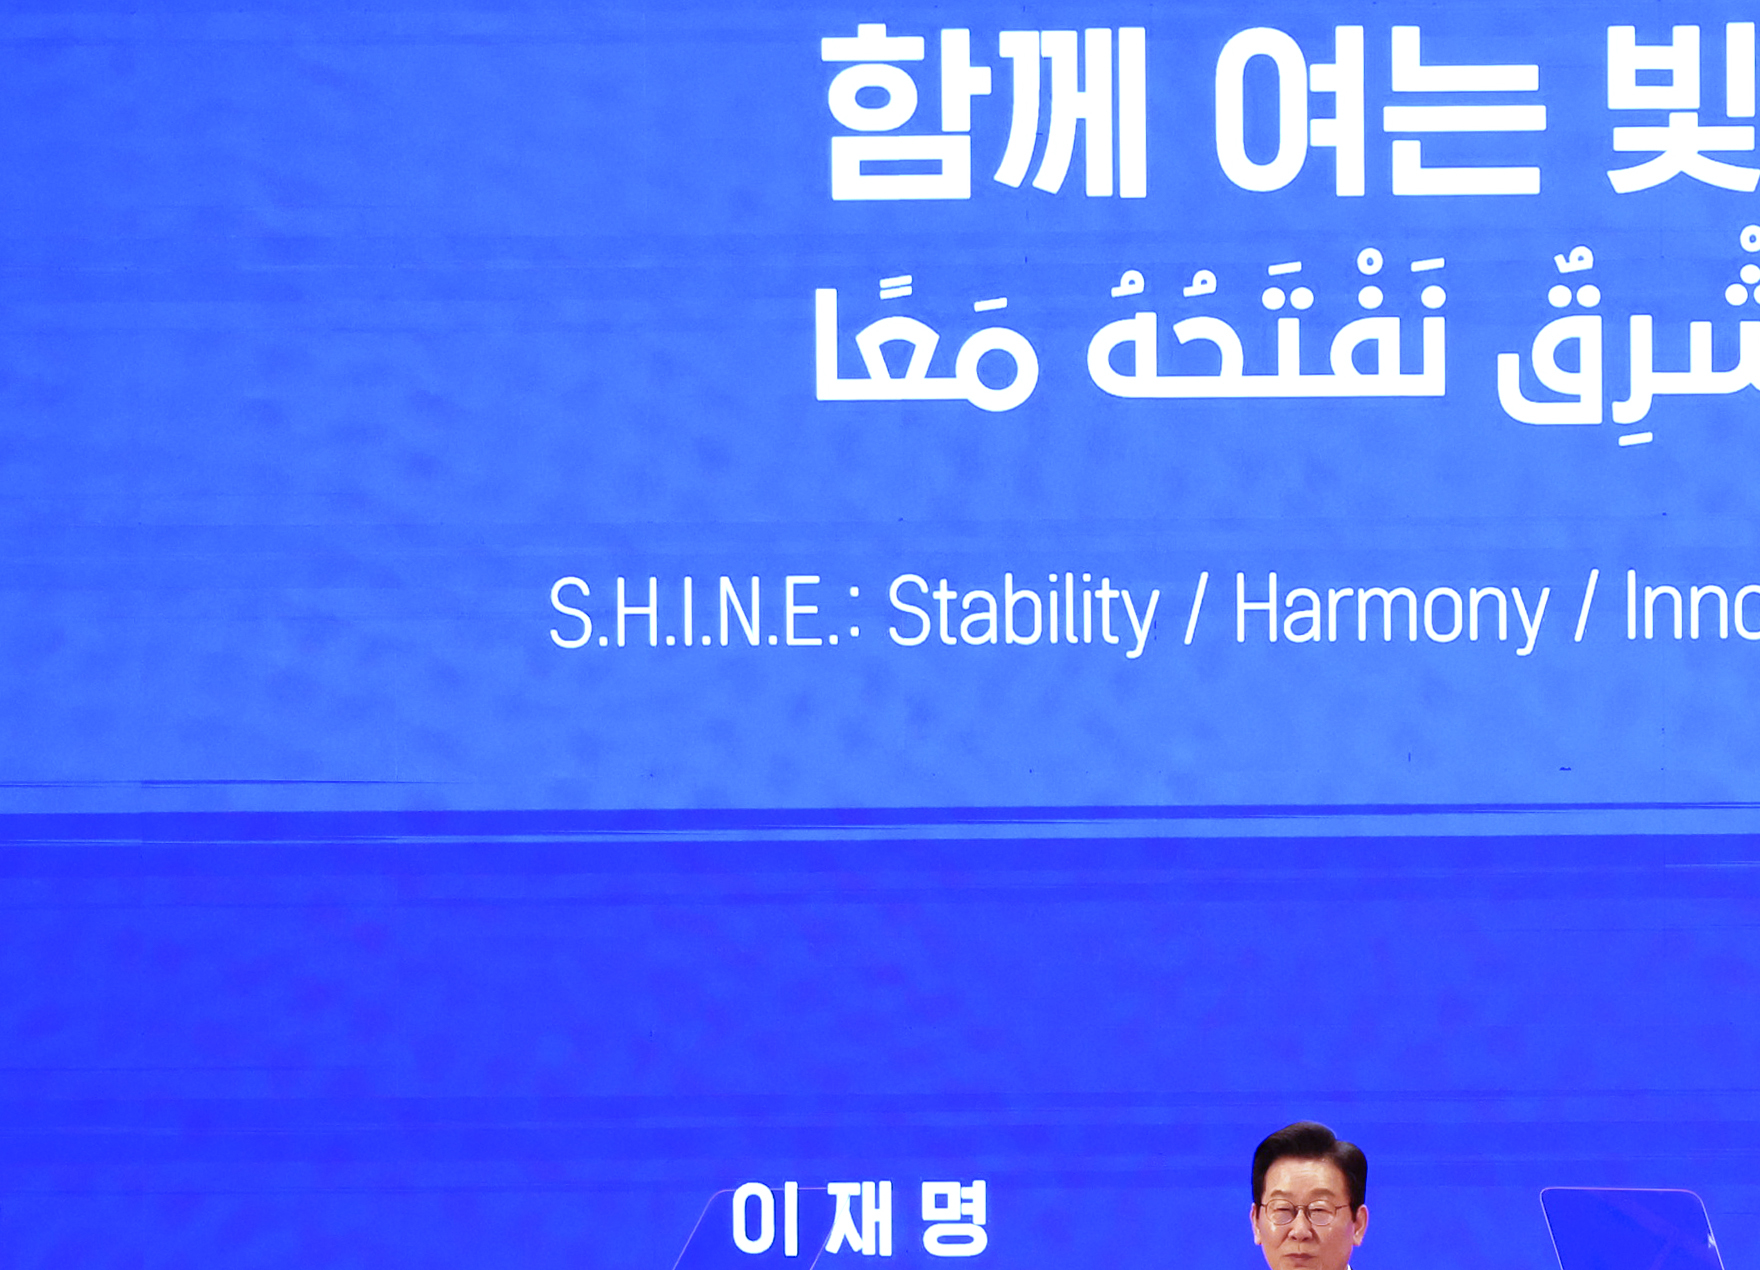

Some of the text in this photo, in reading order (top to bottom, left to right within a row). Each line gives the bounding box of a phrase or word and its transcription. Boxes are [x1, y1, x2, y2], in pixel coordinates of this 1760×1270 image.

[822, 24, 1147, 200] 함께
[1216, 25, 1547, 197] 여는
[888, 571, 1160, 659] Stability
[1236, 571, 1550, 656] Harmony
